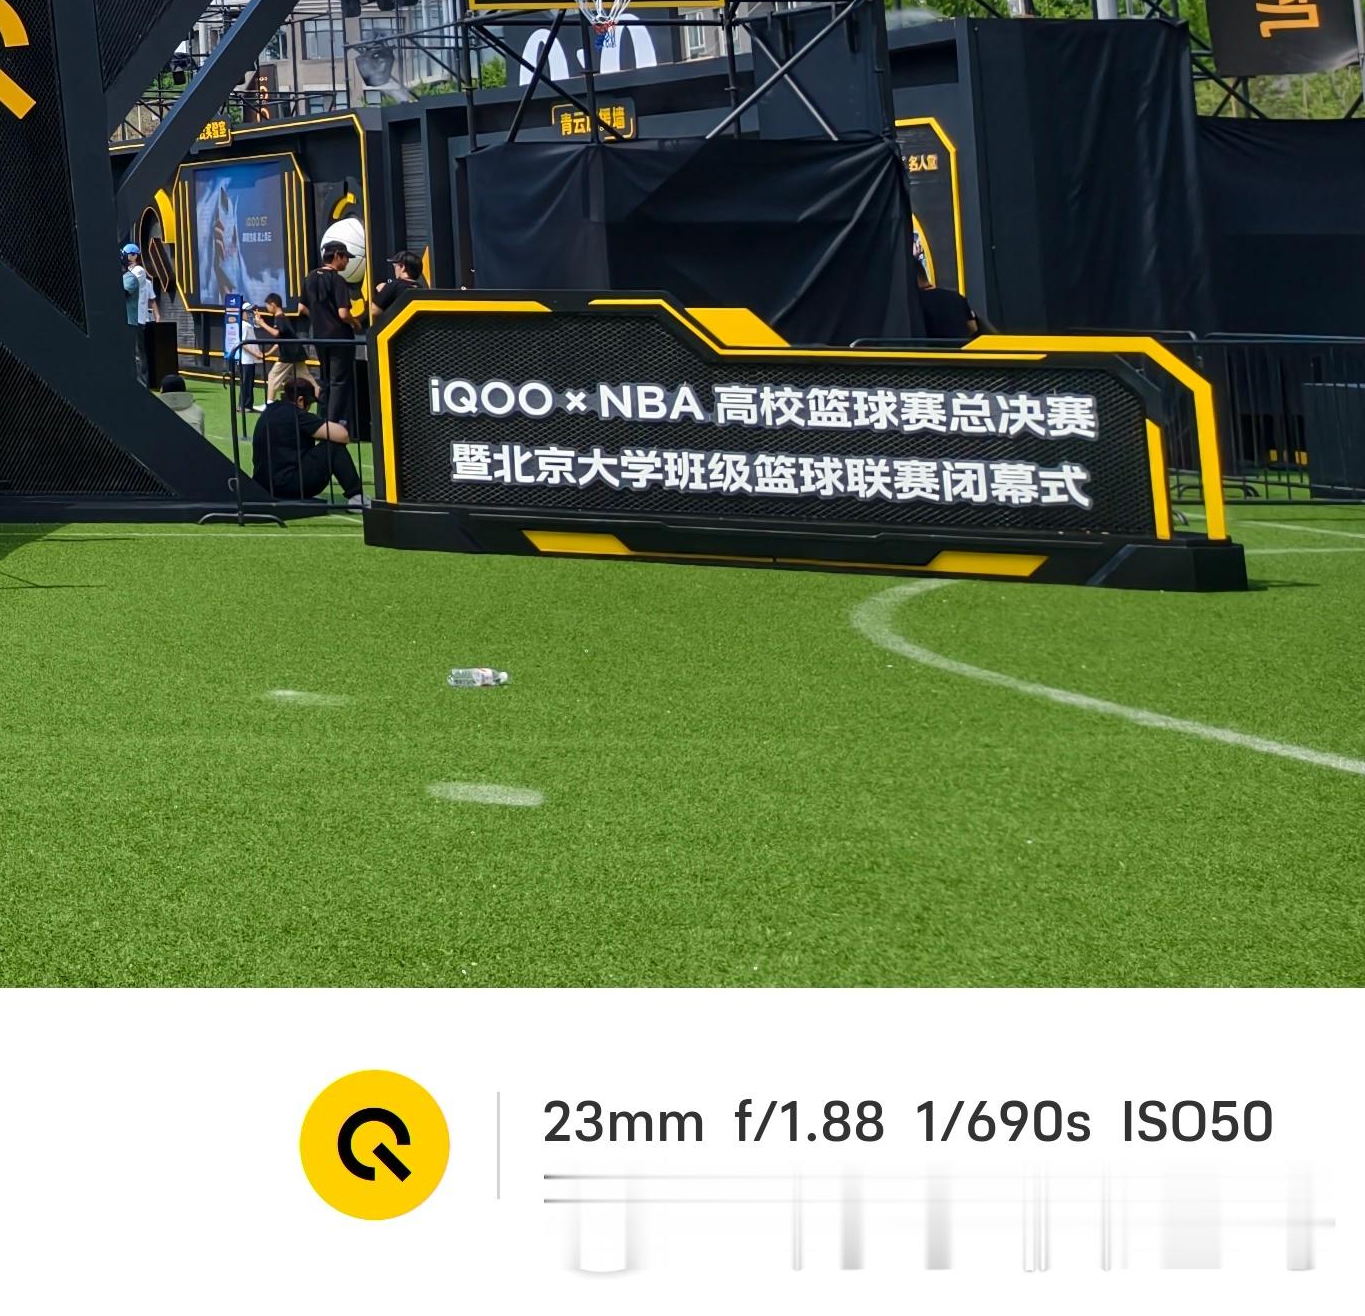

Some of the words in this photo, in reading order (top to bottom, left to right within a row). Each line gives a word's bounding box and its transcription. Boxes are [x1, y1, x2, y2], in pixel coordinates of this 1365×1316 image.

[600, 383, 705, 422] NBA
[713, 383, 1097, 441] 高校篮球赛总决赛
[451, 442, 1094, 509] 暨北京大学班级篮球联赛闭幕式
